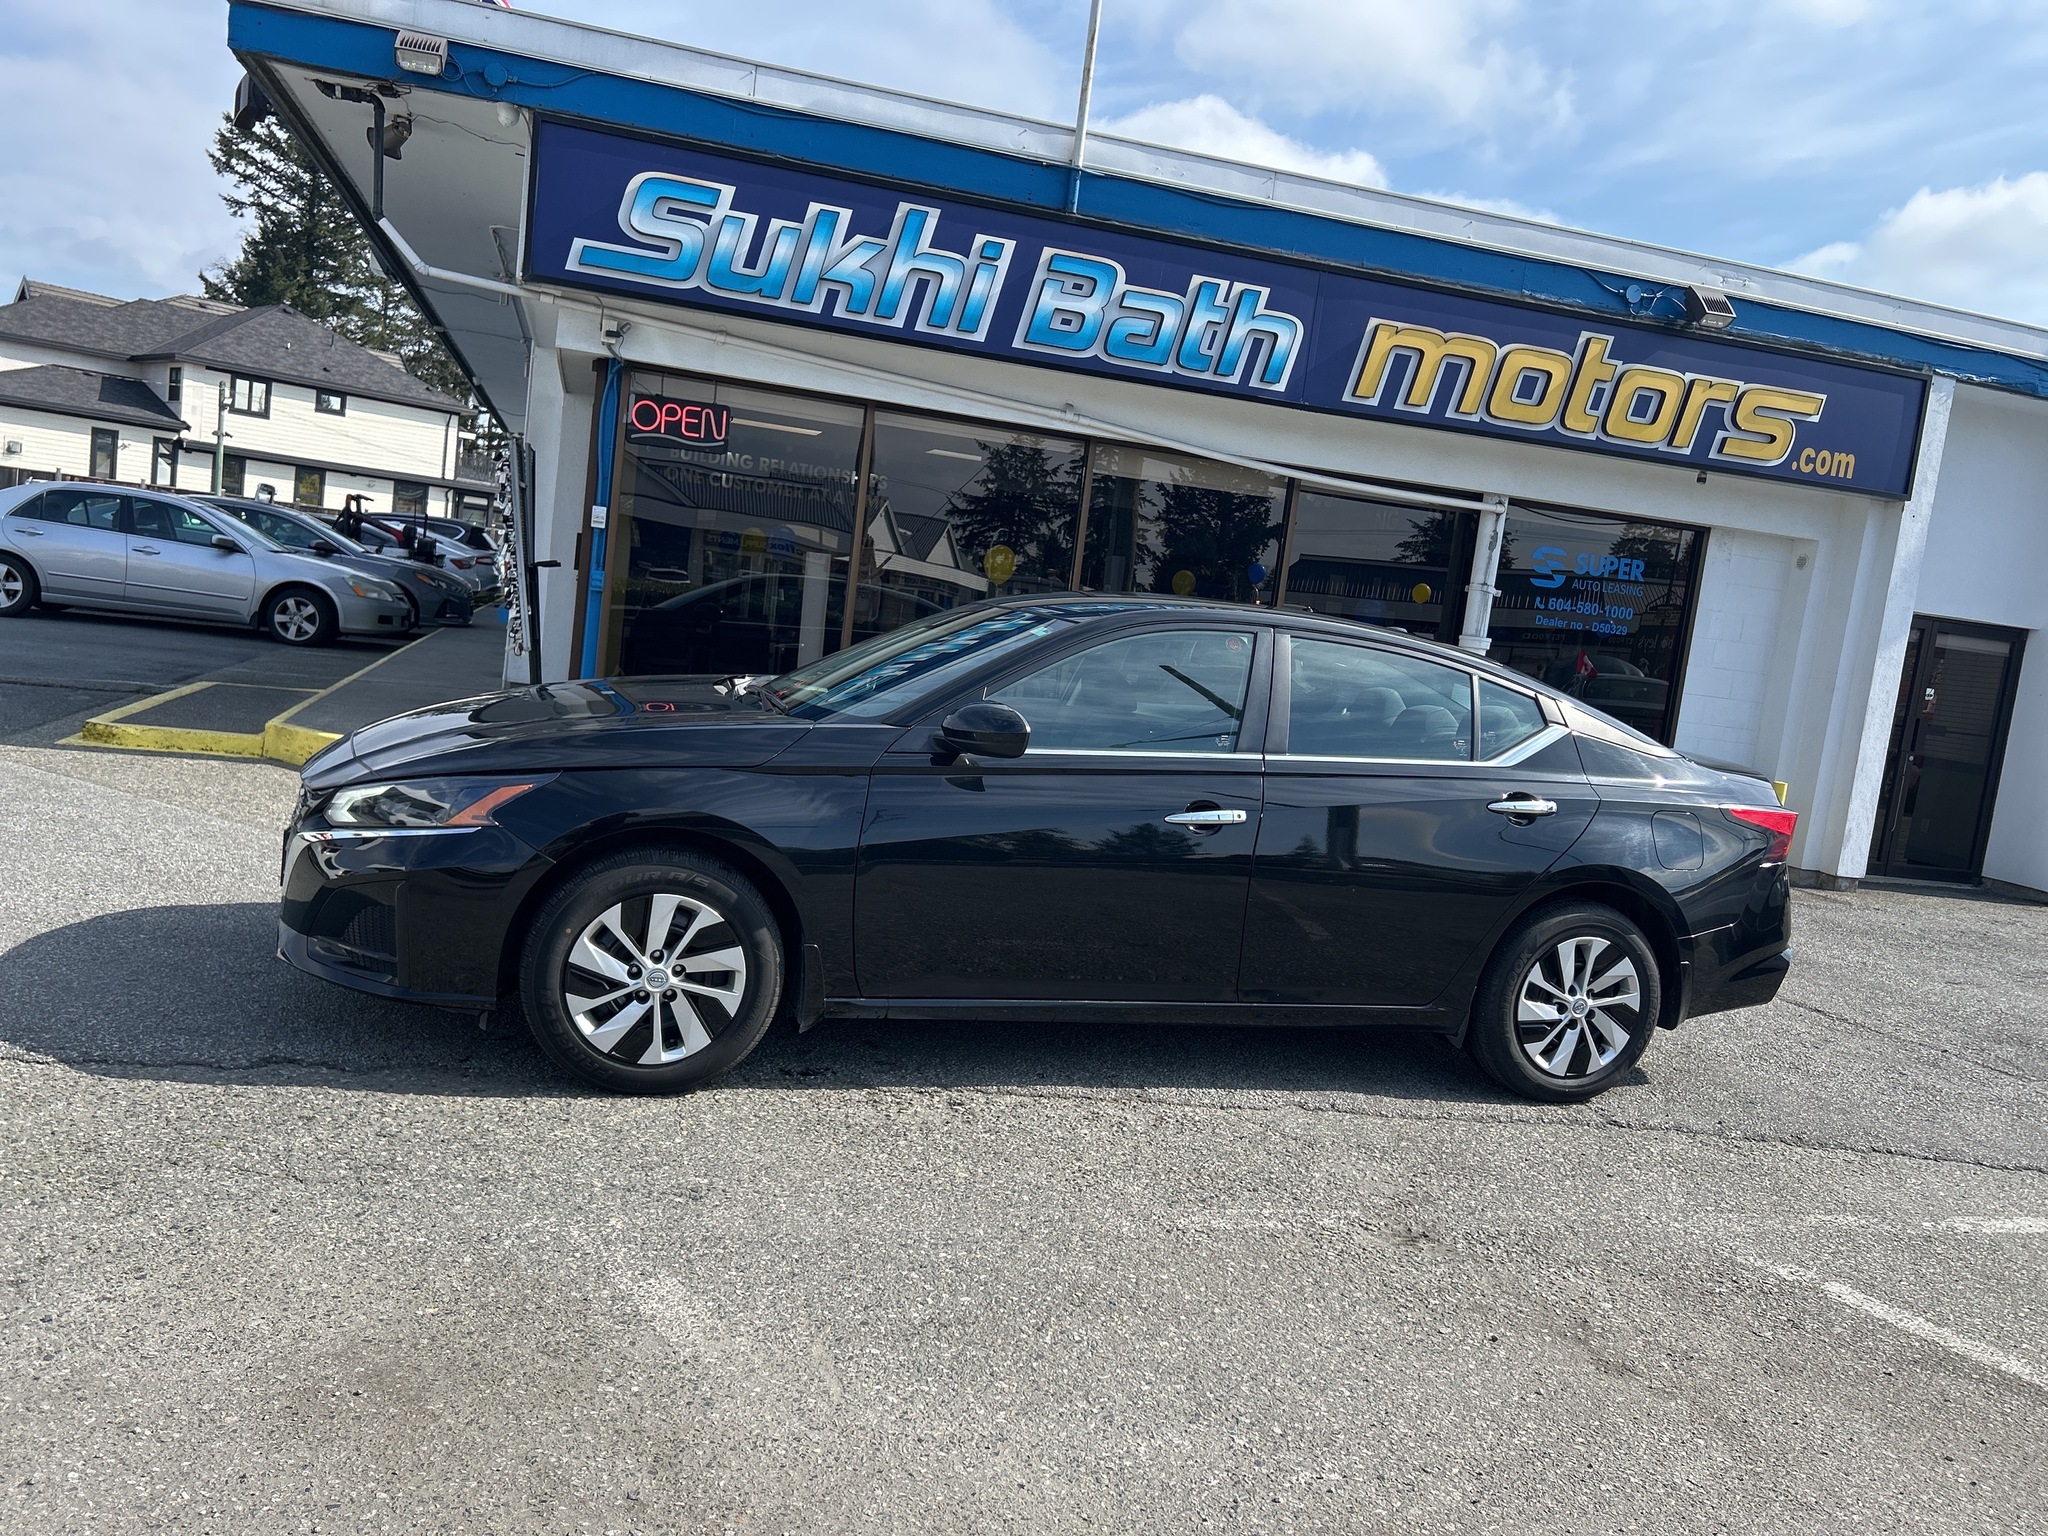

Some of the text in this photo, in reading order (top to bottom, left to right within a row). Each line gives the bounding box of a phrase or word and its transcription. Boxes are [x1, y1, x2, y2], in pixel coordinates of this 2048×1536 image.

[565, 171, 1016, 343] Sukhi
[1013, 246, 1304, 392] Bath
[1342, 317, 1827, 468] motors
[631, 400, 727, 440] OPEN
[670, 449, 888, 489] BUILDING RELATIONSHPS
[709, 471, 804, 498] CUSTOMER
[1573, 552, 1645, 582] SUPER
[1572, 579, 1644, 597] AUTO LEASING
[1548, 598, 1633, 620] 604-580-1000
[1535, 615, 1568, 628] Dealer
[1570, 620, 1583, 630] no
[1592, 622, 1628, 635] D50329
